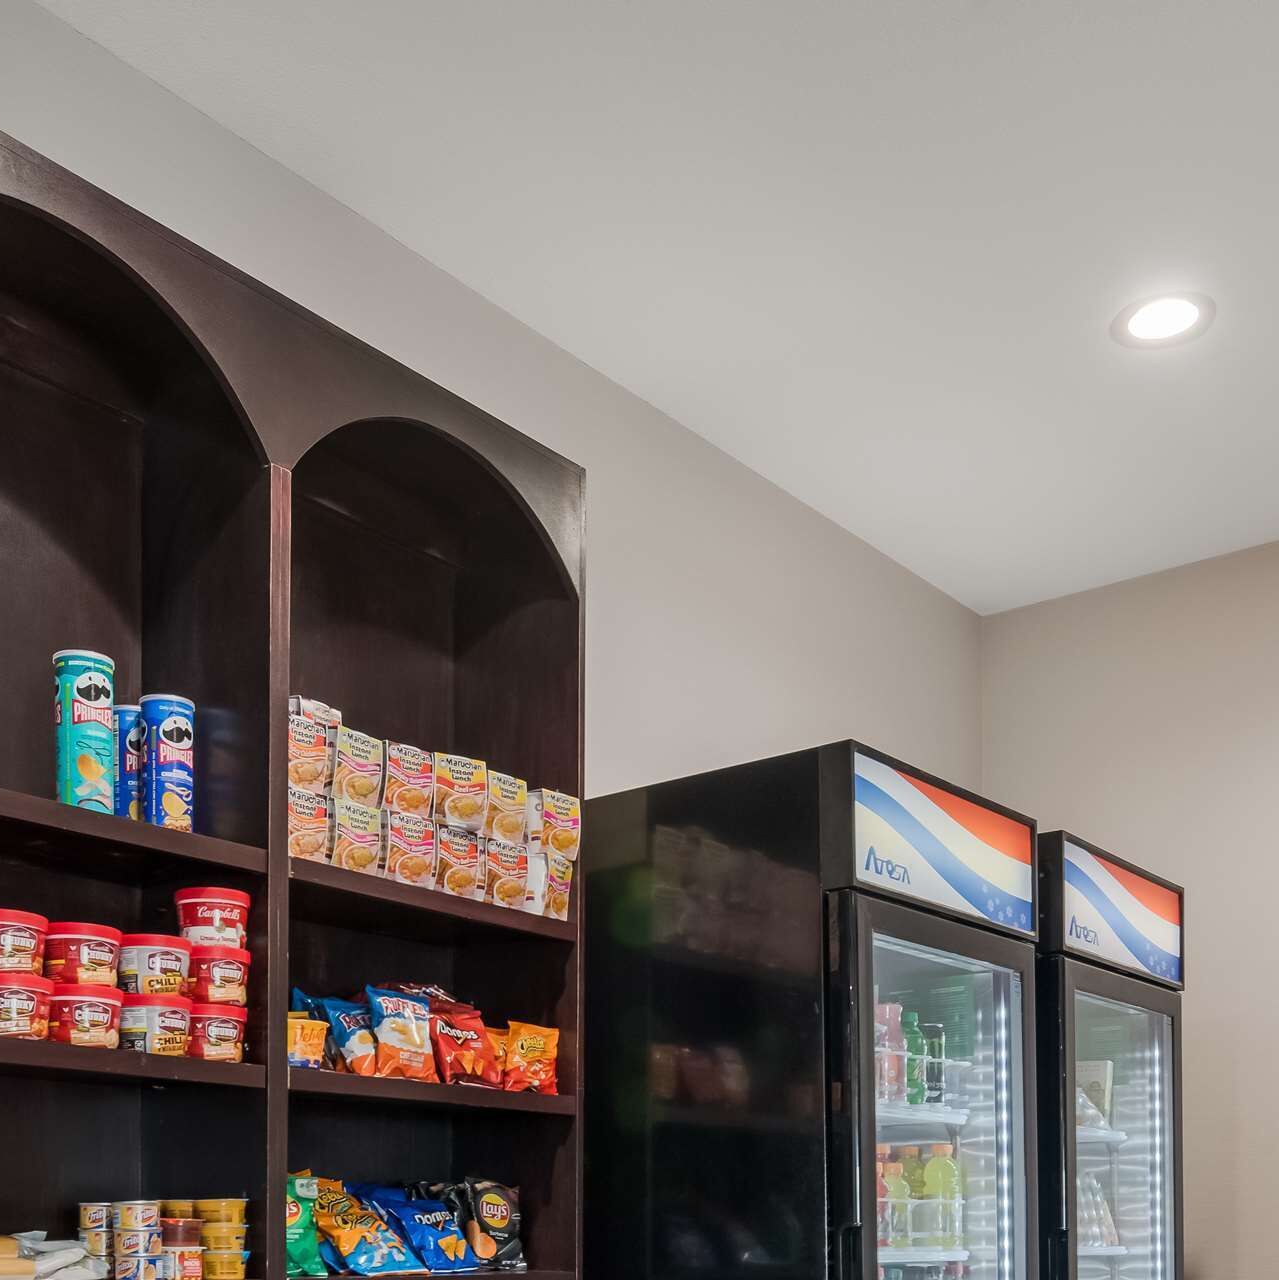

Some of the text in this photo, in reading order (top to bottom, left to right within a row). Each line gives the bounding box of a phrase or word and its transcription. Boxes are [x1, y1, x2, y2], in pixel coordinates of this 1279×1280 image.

[74, 703, 112, 728] PRINGLES
[289, 718, 324, 734] Maruchan
[347, 733, 379, 749] Maruchan
[397, 747, 430, 761] Maruchan
[446, 758, 482, 770] Maruchan
[448, 767, 474, 776] Instant
[452, 774, 472, 782] Lunch
[289, 791, 325, 806] Maruchan
[293, 801, 316, 811] Instant
[295, 808, 313, 817] Lunch
[346, 805, 377, 819] Maruchan
[399, 815, 432, 829] Maruchan
[197, 905, 241, 920] Campbell's
[148, 978, 177, 987] CHILI
[382, 998, 426, 1016] RUFFLES
[482, 1201, 507, 1220] Lay's
